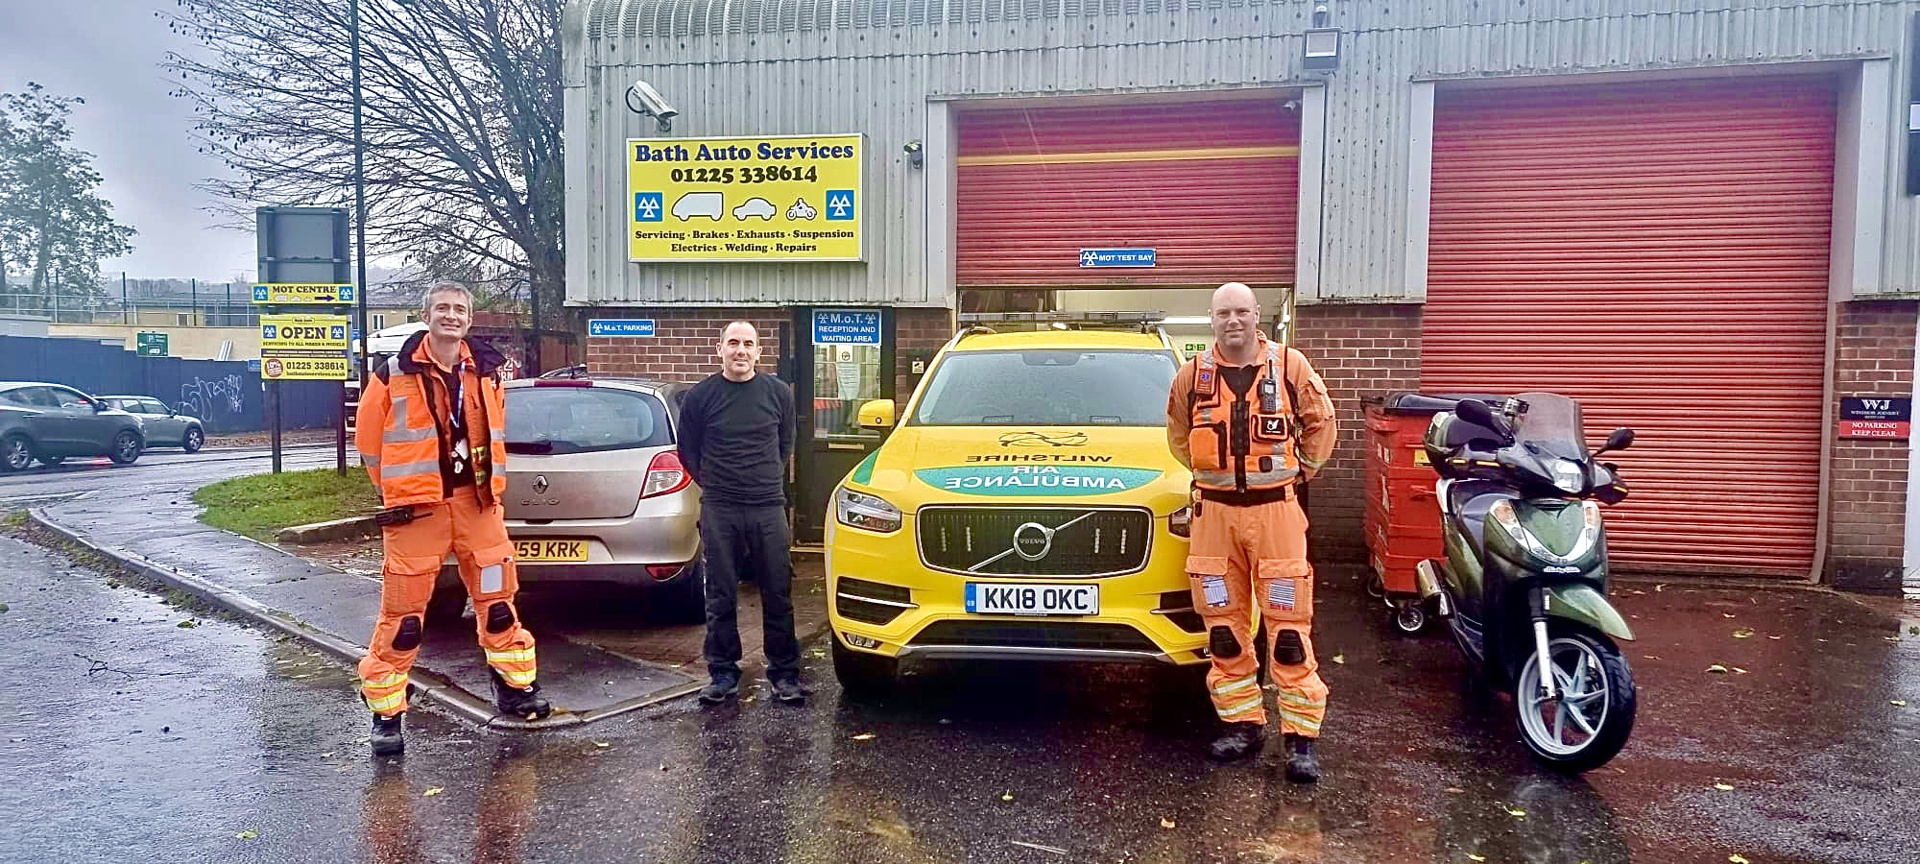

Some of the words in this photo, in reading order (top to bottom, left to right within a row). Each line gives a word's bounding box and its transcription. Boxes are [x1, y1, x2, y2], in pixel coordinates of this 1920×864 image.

[635, 144, 689, 161] Bath
[695, 144, 752, 161] Auto
[757, 142, 854, 160] Services
[671, 168, 734, 184] 01225
[739, 165, 818, 183] 338614
[635, 231, 685, 241] Servicing
[692, 230, 729, 239] Brakes
[737, 230, 785, 239] Exhausts
[793, 229, 854, 240] Suspension
[671, 243, 717, 252] Electrics
[725, 243, 768, 253] Welding
[776, 243, 817, 253] Repairs
[281, 326, 327, 339] OPEN
[286, 361, 312, 370] 01225
[314, 361, 345, 370] 338614
[1861, 399, 1892, 410] WJ
[545, 541, 580, 558] KRK
[984, 588, 1036, 609] KK18
[1043, 588, 1089, 610] OKC
